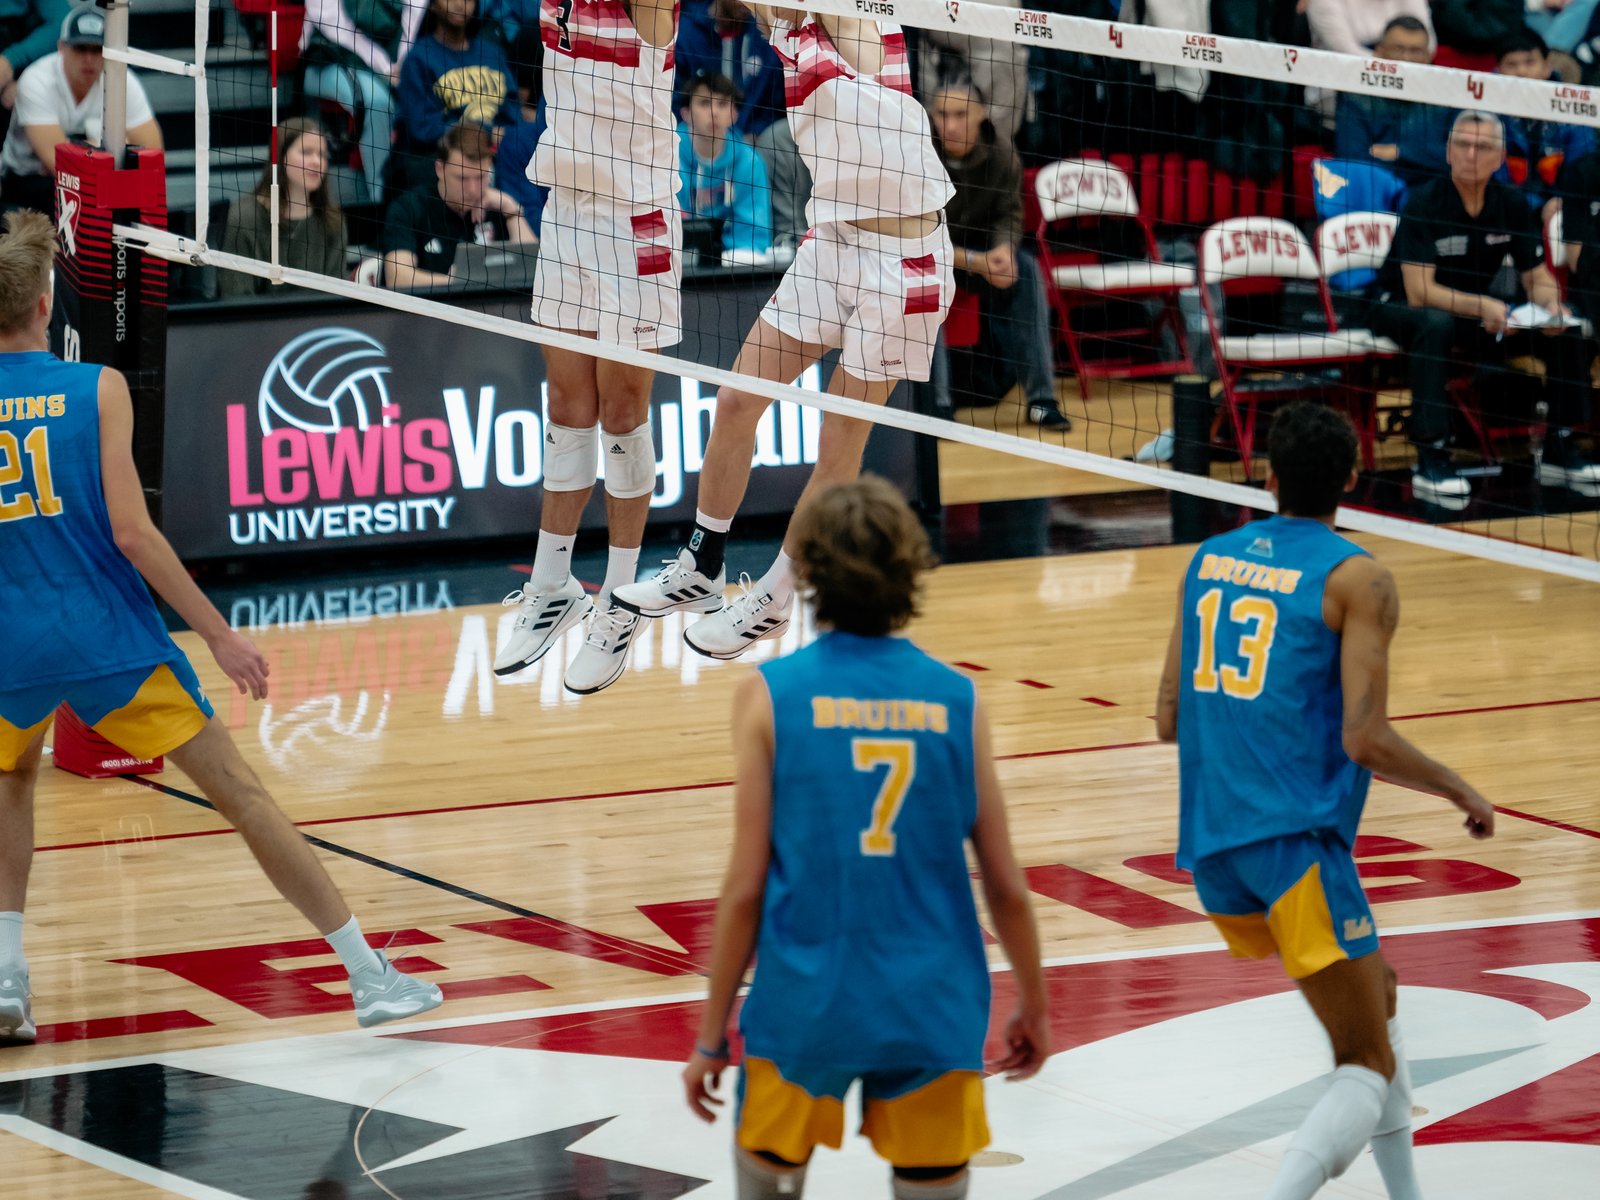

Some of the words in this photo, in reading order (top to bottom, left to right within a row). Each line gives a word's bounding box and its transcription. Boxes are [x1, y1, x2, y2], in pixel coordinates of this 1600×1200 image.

[856, 0, 894, 16] FLYERS
[1018, 10, 1047, 24] LEWIS
[1014, 22, 1053, 39] FLYERS
[1185, 34, 1216, 48] LEWIS
[1181, 46, 1223, 64] FLYERS
[1364, 60, 1398, 74] LEWIS
[1360, 72, 1404, 90] FLYERS
[1554, 87, 1590, 100] LEWIS
[1551, 98, 1598, 117] FLYERS
[58, 171, 80, 191] LEWIS
[1047, 168, 1122, 201] LEWIS
[1219, 230, 1300, 262] LEWIS
[116, 234, 127, 279] ports
[227, 404, 453, 506] Lewis
[0, 426, 64, 522] 21
[229, 497, 455, 545] UNIVERSITY
[1198, 553, 1302, 595] BRUINS
[1193, 588, 1278, 700] 13
[812, 696, 948, 734] BRUINS
[101, 758, 120, 769] (800)
[852, 738, 916, 857] 7
